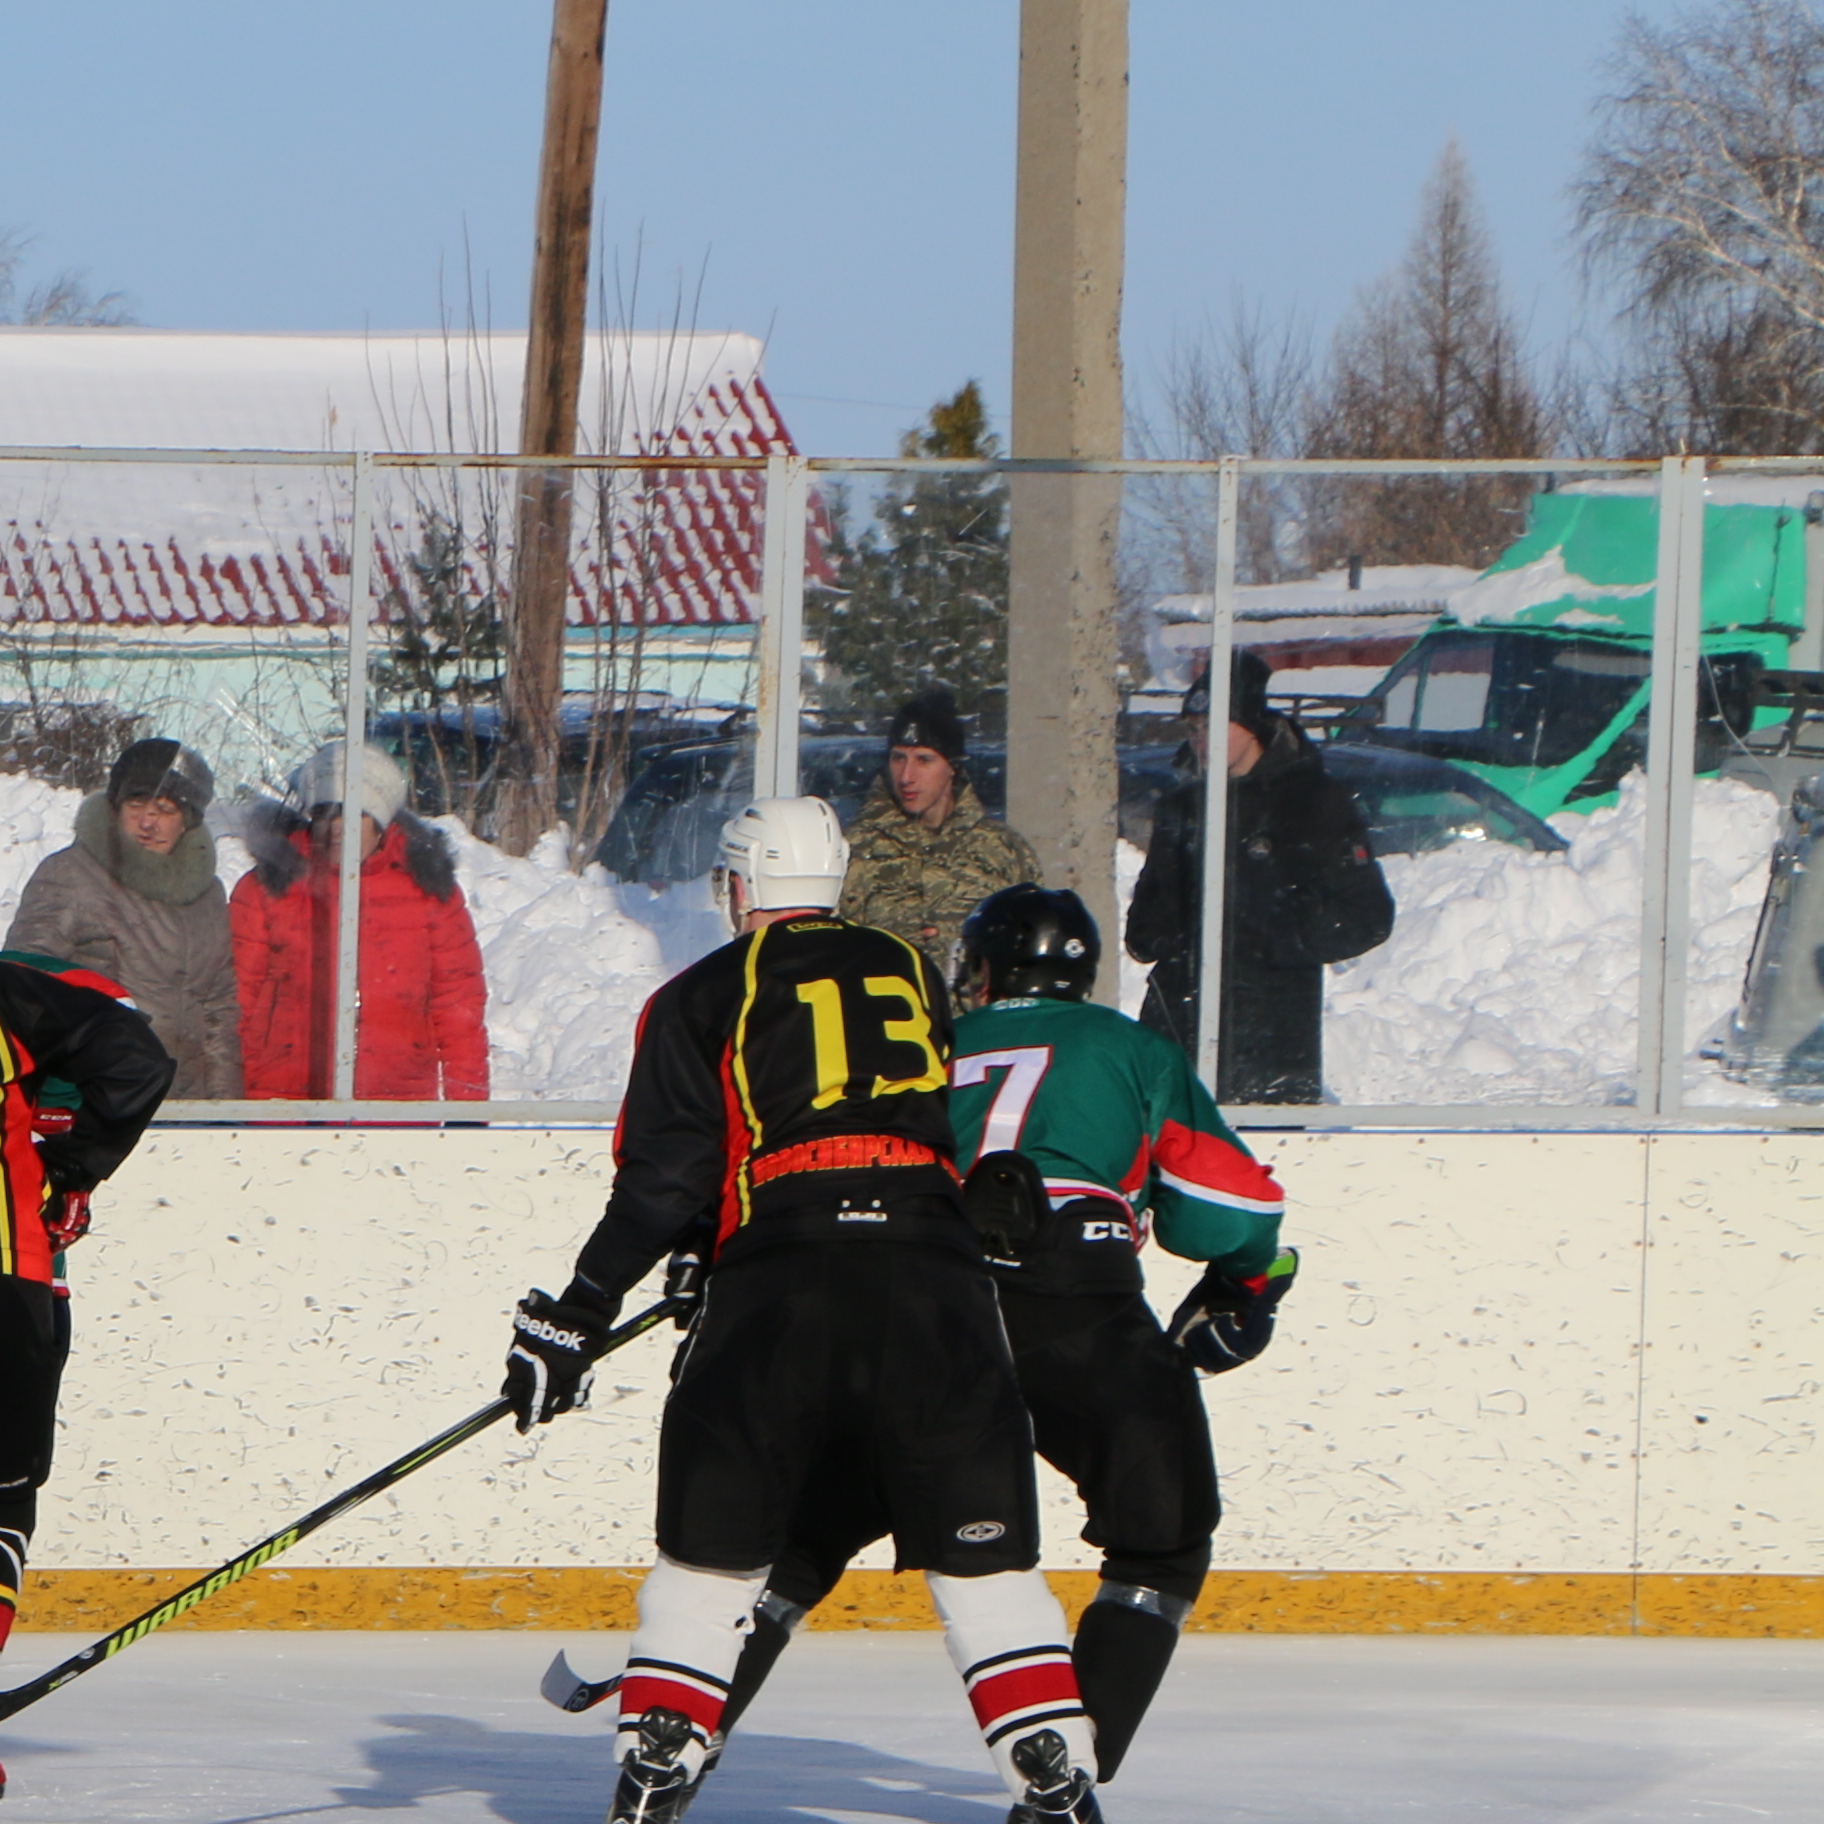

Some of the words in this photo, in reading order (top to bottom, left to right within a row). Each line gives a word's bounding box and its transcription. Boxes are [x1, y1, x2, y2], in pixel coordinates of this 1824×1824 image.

[796, 975, 948, 1111] 13
[951, 1044, 1054, 1176] 7
[1082, 1221, 1134, 1242] CC
[105, 1527, 300, 1660] WARRIOR
